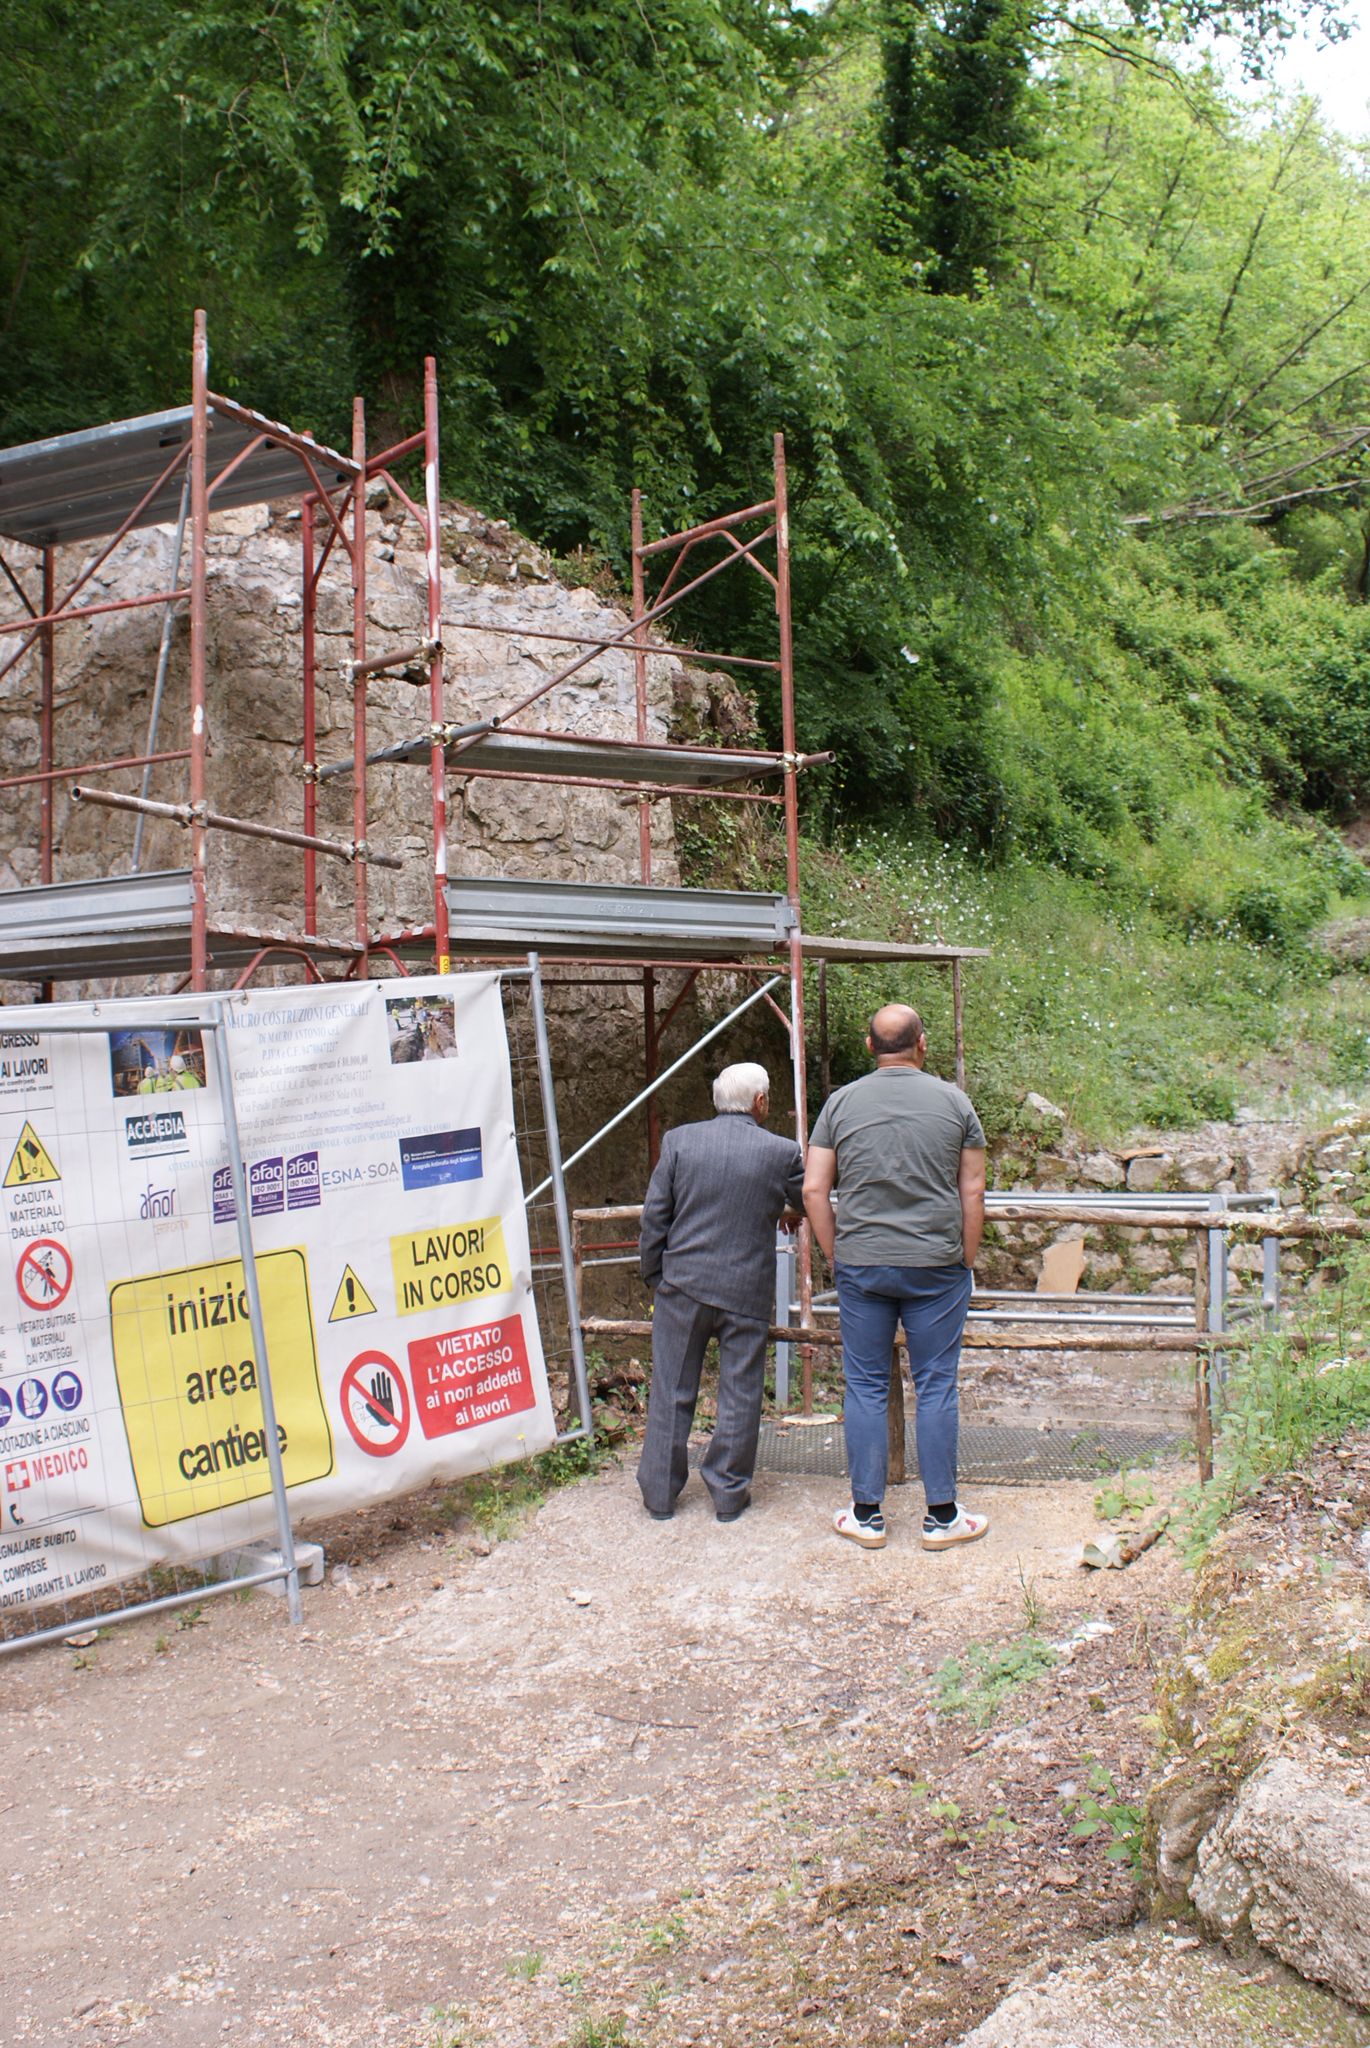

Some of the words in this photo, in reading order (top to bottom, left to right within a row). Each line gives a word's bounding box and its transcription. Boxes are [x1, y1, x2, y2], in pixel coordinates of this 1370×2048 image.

[263, 1006, 323, 1026] COSTRUZIONI
[326, 1001, 369, 1019] GENERALI
[1, 1061, 11, 1078] AI
[14, 1058, 48, 1076] LAVORI
[127, 1116, 186, 1140] ACCREDIA
[251, 1163, 283, 1182] afaq
[287, 1158, 318, 1176] afaq
[254, 1185, 265, 1194] ISO
[266, 1182, 281, 1192] 9001
[289, 1179, 299, 1187] ISO
[301, 1176, 318, 1186] 14001
[14, 1189, 53, 1205] CADUTA
[10, 1205, 62, 1222] MATERIALI
[412, 1228, 485, 1266] LAVORI
[403, 1279, 424, 1308] IN
[430, 1263, 501, 1302] CORSO
[17, 1318, 45, 1334] VIETATO
[46, 1313, 77, 1329] BUTTARE
[31, 1331, 65, 1347] MATERIALI
[436, 1327, 501, 1357] VIETATO
[27, 1351, 38, 1365] DAI
[39, 1345, 72, 1362] PONTEGGI
[186, 1360, 257, 1405] area
[426, 1392, 440, 1410] ai
[444, 1385, 474, 1405] non
[476, 1367, 521, 1395] addetti
[455, 1408, 470, 1426] ai
[472, 1394, 511, 1421] lavori
[44, 1428, 49, 1441] A
[50, 1418, 90, 1441] CIASCUNO
[32, 1447, 88, 1482] MEDICO
[44, 1530, 76, 1547] SUBITO
[3, 1557, 48, 1583] COMPRESE
[26, 1576, 65, 1600] DURANTE
[65, 1574, 73, 1588] IL
[74, 1564, 107, 1585] LAVORO
